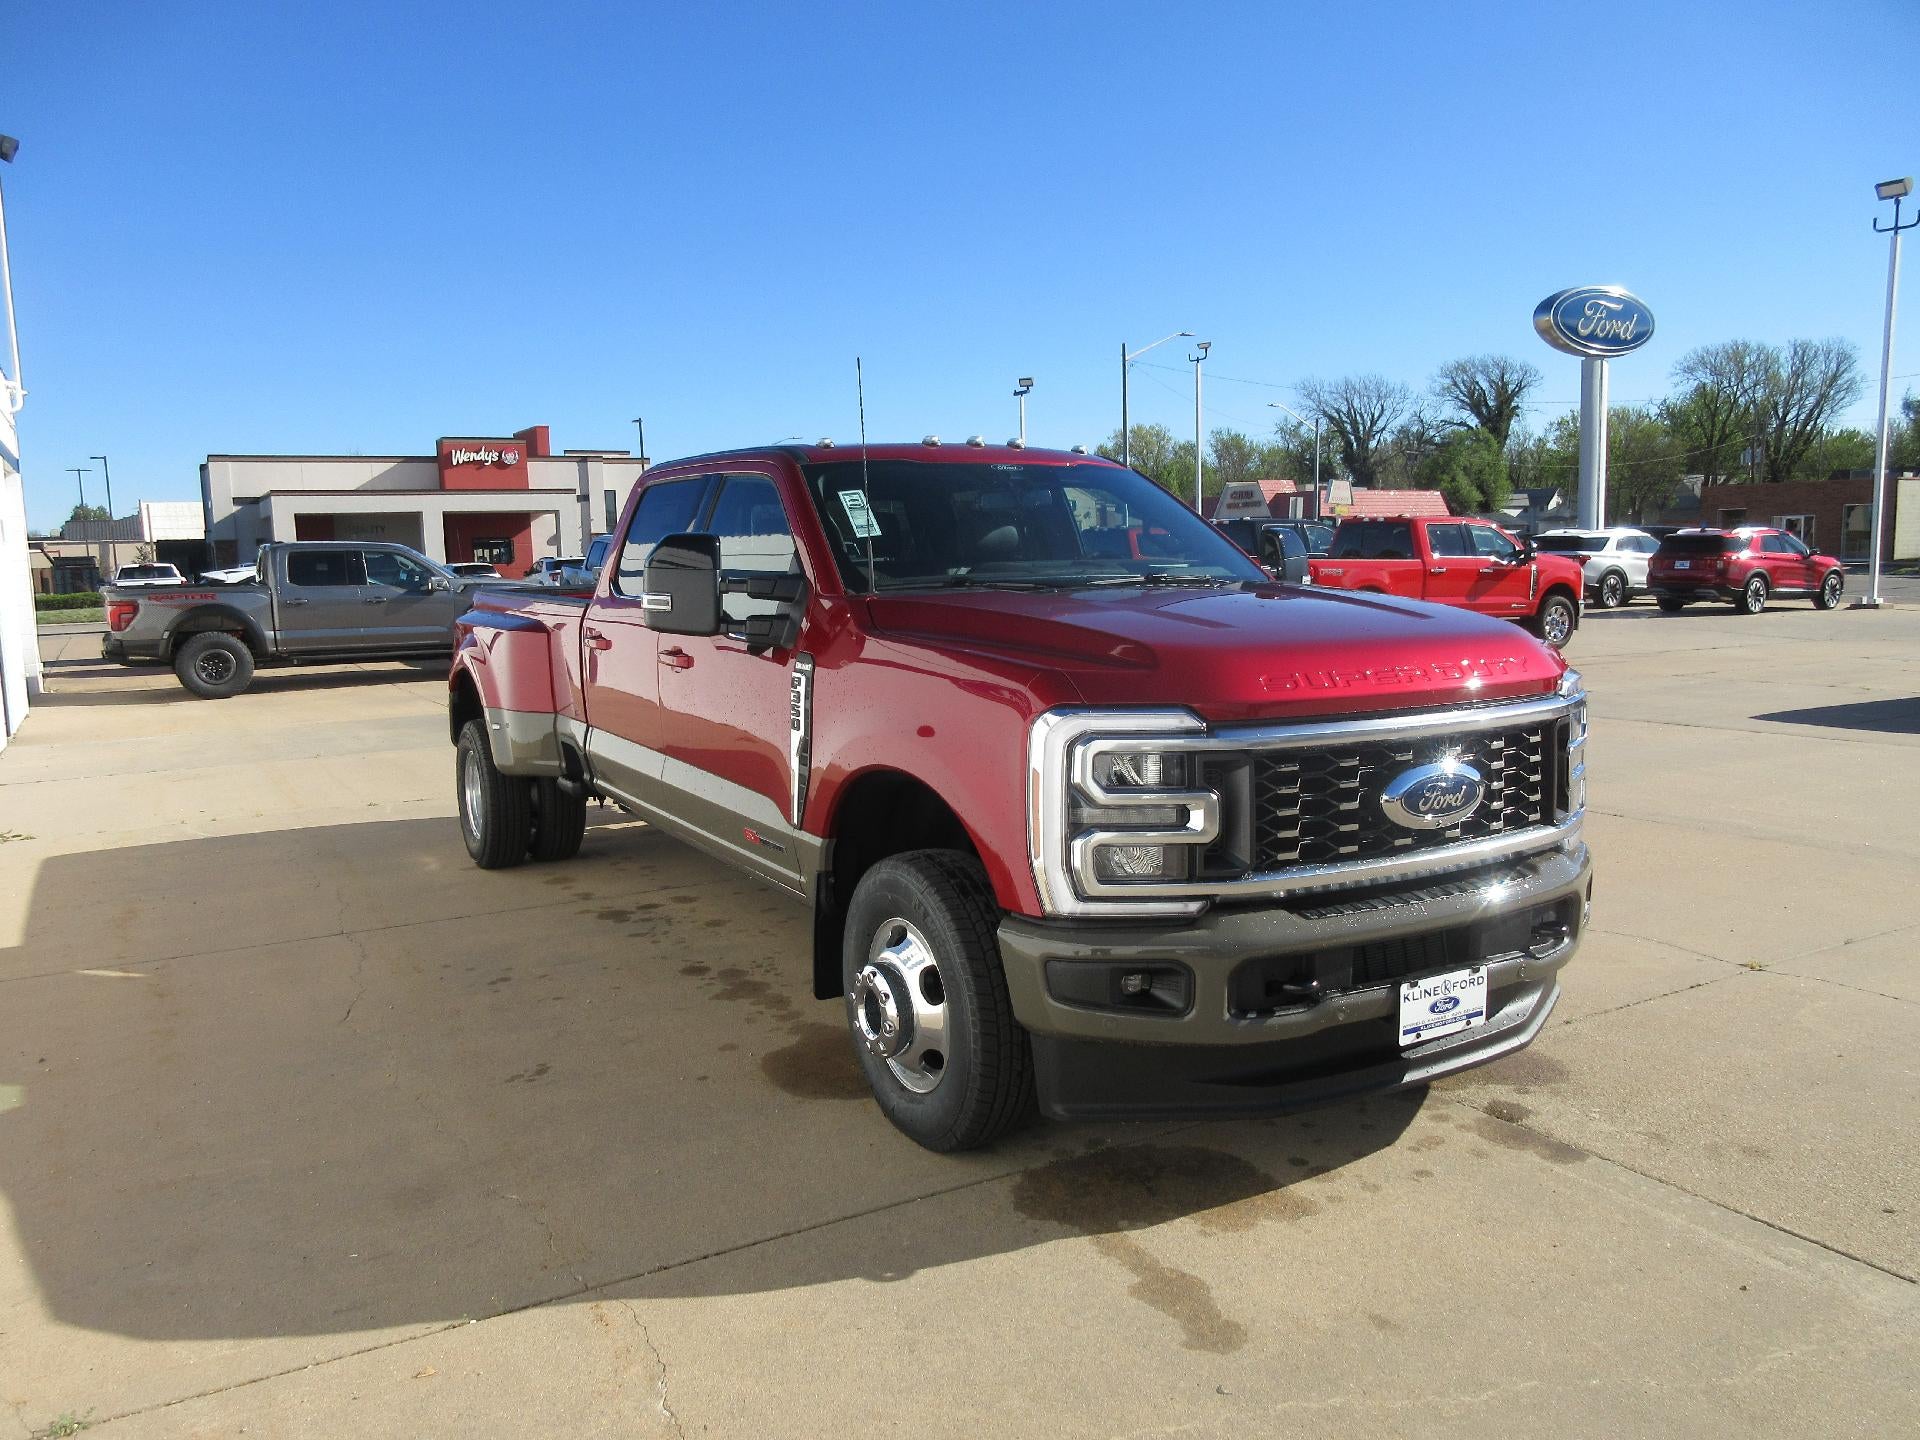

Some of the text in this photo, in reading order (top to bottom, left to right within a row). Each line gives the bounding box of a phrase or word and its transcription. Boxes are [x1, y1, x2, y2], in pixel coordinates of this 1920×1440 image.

[1577, 299, 1638, 341] Ford
[451, 445, 499, 466] Wendy's
[148, 592, 217, 601] RAPTOR
[1258, 656, 1528, 692] SUPER DUTY
[1419, 781, 1467, 812] Ford
[1403, 985, 1441, 1004] KLINE
[1452, 975, 1485, 992] FORD
[1434, 998, 1455, 1013] Ford
